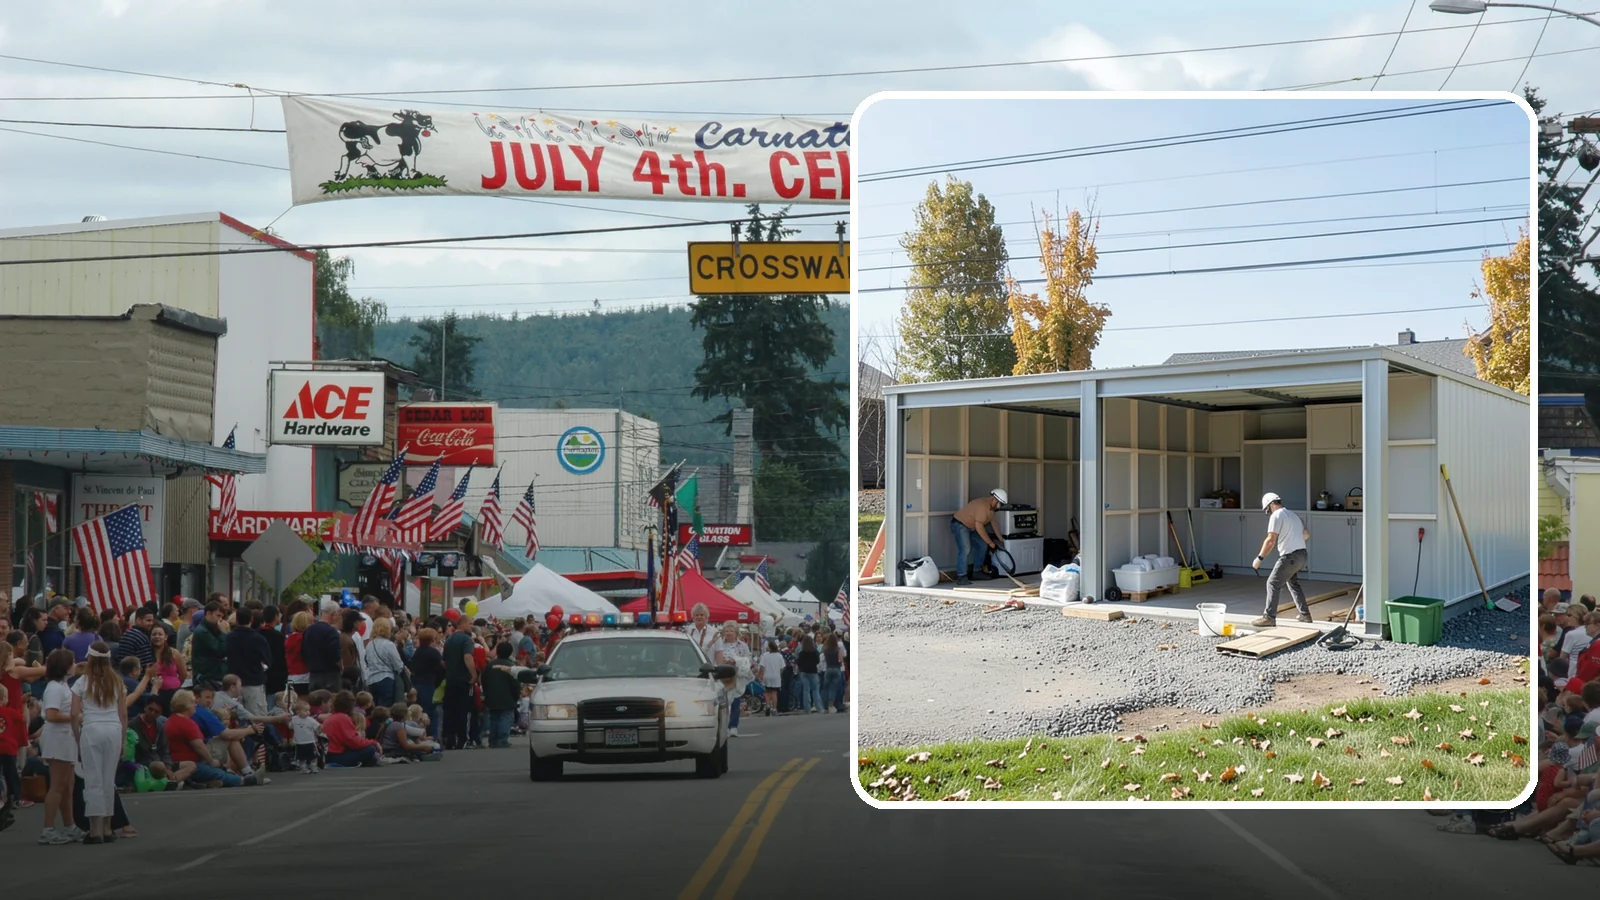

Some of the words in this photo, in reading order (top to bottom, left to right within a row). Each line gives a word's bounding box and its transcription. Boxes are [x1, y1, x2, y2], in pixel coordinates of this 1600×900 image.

[481, 141, 605, 191] JULY
[632, 150, 746, 197] 4th.
[697, 254, 850, 279] CROSSWA
[283, 380, 373, 420] ACE
[405, 409, 453, 422] CEDAR
[283, 421, 370, 436] Hardware
[416, 428, 476, 447] Coca-Cola
[353, 466, 386, 481] Simpl
[95, 485, 124, 494] Vincent
[126, 486, 136, 495] de
[137, 486, 155, 495] Paul
[212, 515, 331, 535] HARDARE
[688, 526, 741, 535] CRNATION
[699, 535, 730, 543] GLASS
